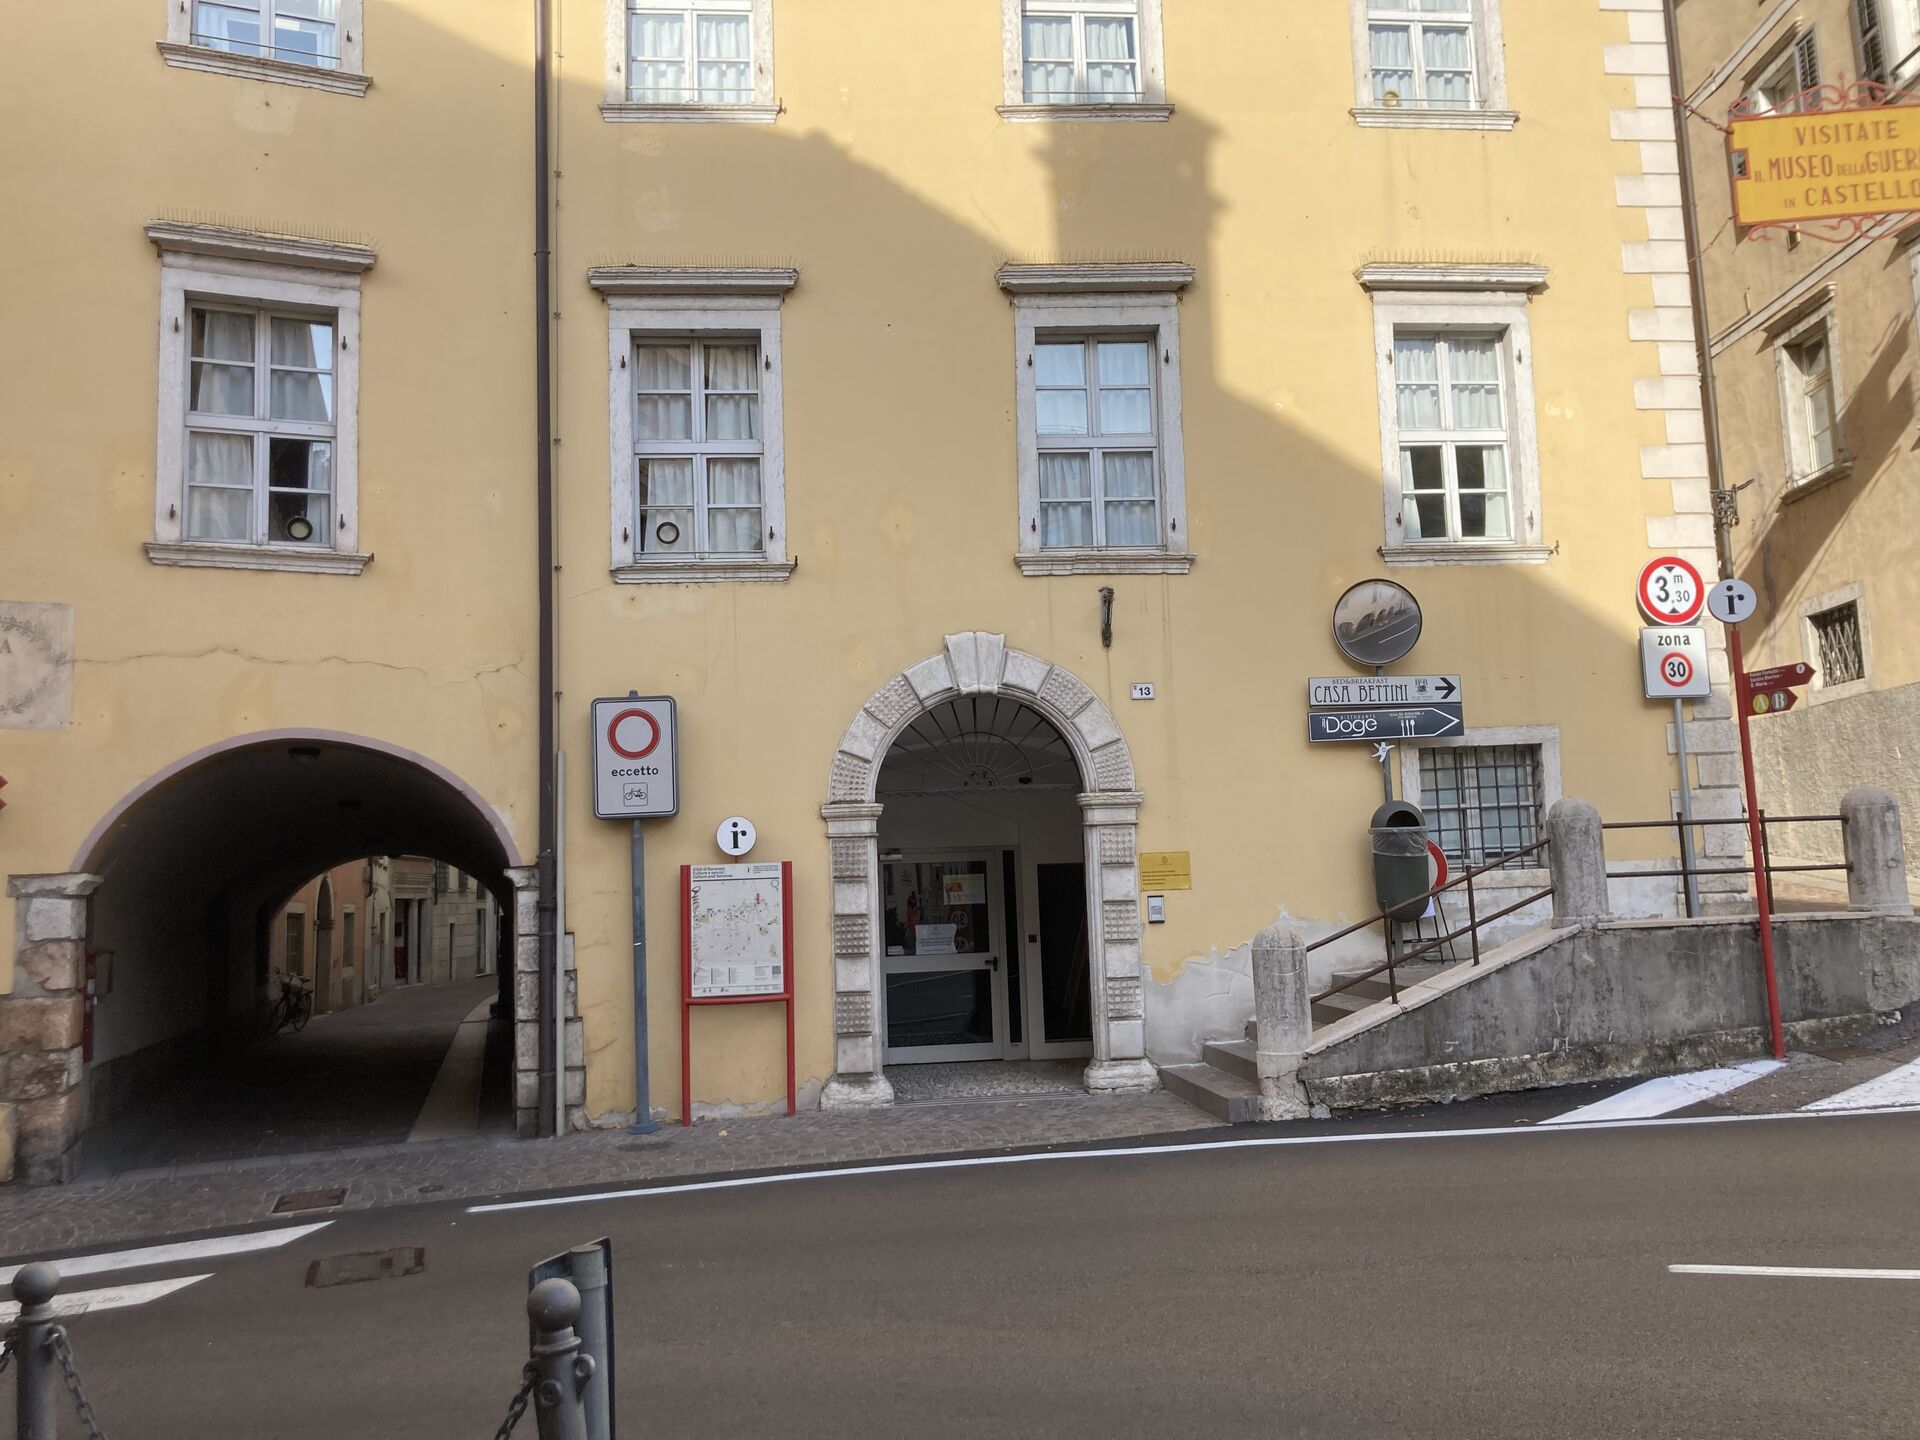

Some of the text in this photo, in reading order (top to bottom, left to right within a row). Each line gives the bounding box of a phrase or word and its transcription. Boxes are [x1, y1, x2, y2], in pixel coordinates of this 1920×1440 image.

[1795, 120, 1900, 146] VISITATE
[1754, 169, 1767, 183] IL
[1768, 154, 1833, 182] MUSEO
[1865, 148, 1920, 173] GUER
[1784, 179, 1920, 209] IN CASTELLO
[1673, 574, 1684, 584] m
[1657, 633, 1691, 646] zona
[1667, 661, 1686, 678] 30
[1138, 686, 1151, 696] 13
[1314, 684, 1409, 703] CASA BETTINI
[1774, 692, 1785, 709] B
[611, 765, 659, 777] eccetto
